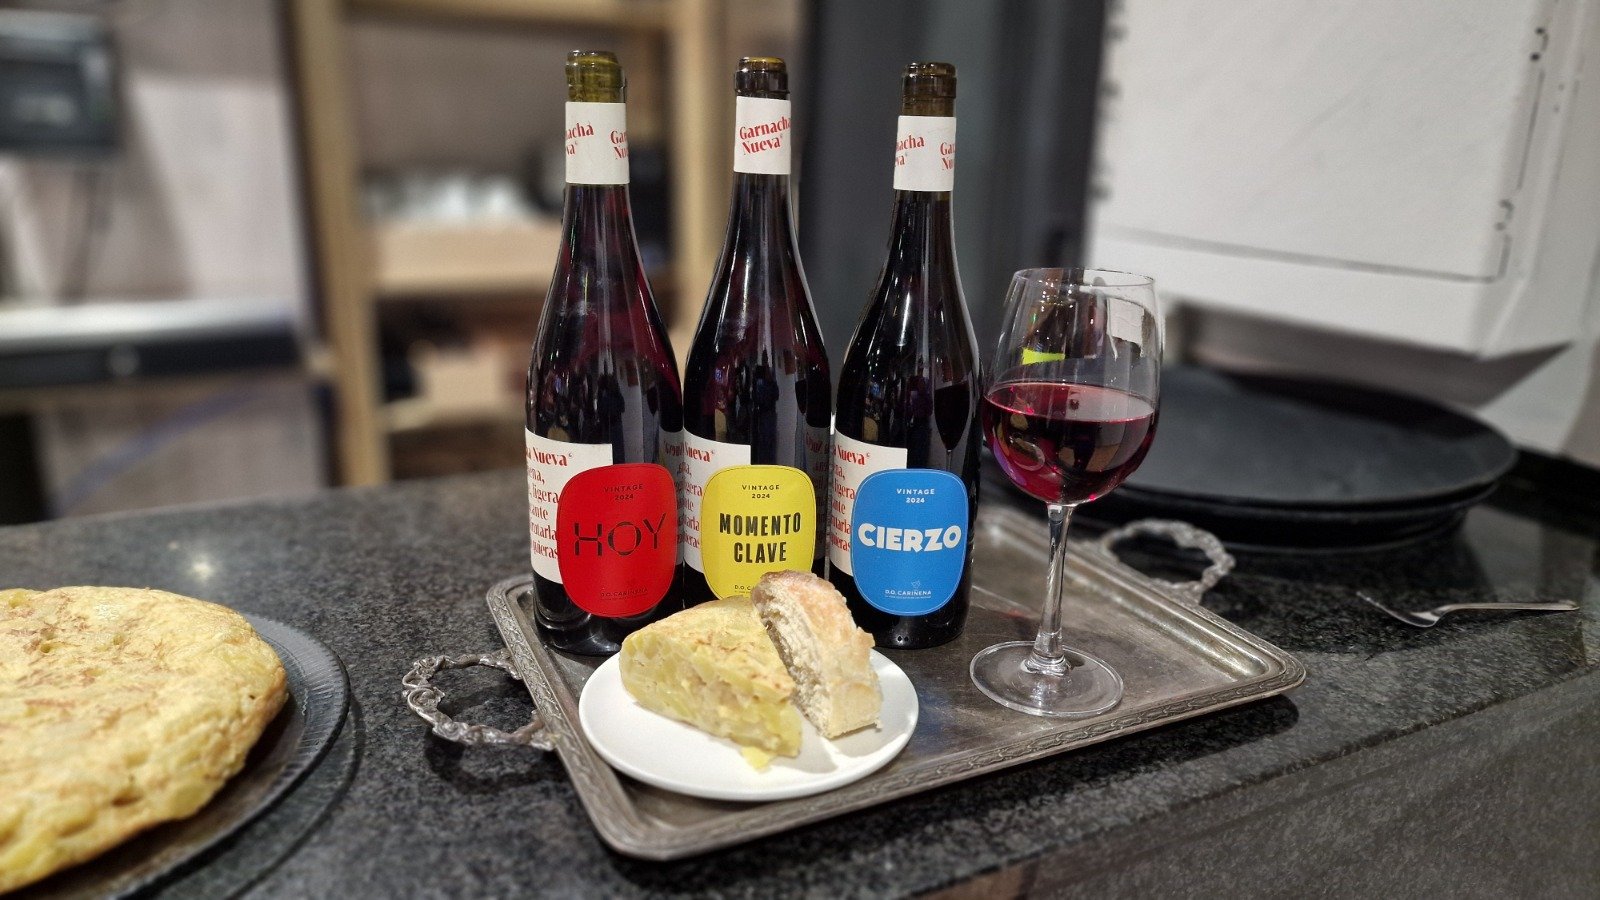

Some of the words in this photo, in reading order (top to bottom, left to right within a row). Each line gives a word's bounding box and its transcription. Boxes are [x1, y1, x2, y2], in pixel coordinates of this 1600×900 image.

[604, 483, 643, 492] VINTAGE
[614, 493, 634, 501] 2024
[574, 512, 667, 557] HOY
[719, 512, 801, 537] MOMENTO
[857, 522, 962, 553] CIERZO
[733, 541, 787, 564] CLAVE
